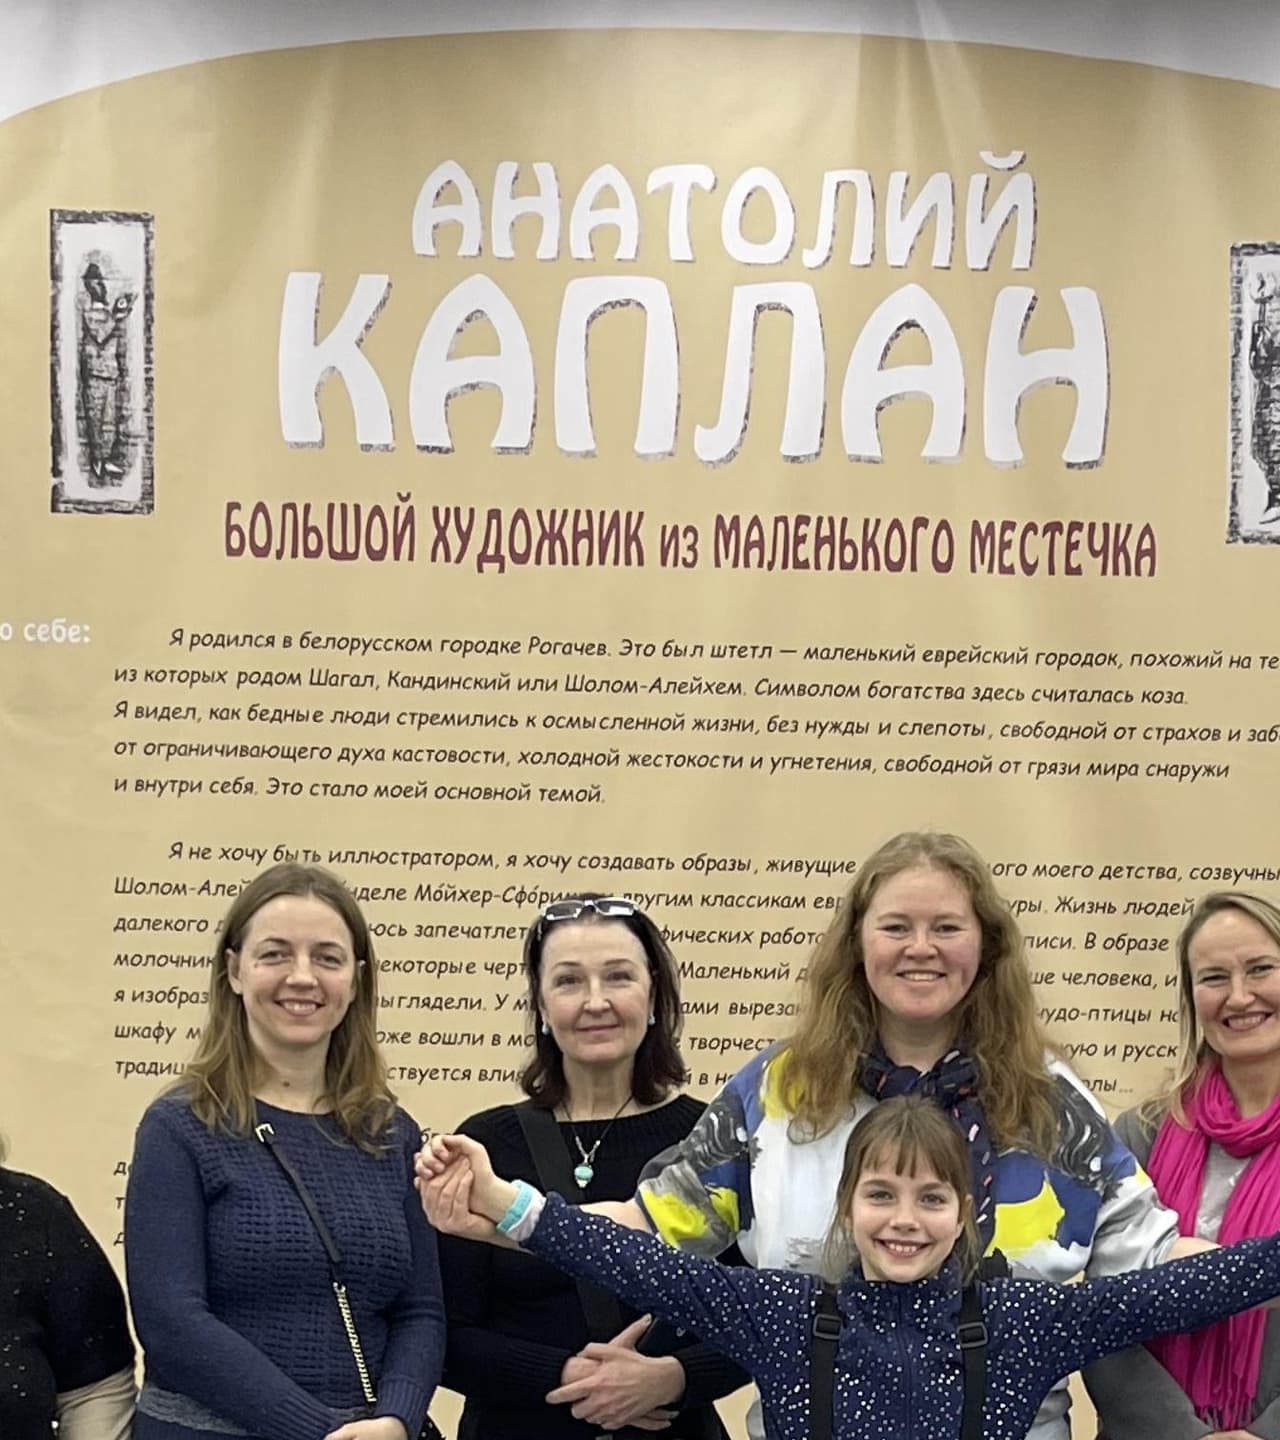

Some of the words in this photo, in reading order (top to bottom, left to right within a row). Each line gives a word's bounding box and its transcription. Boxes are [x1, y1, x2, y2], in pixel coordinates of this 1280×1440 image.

[411, 150, 1037, 272] АНАТОЛИЙ
[276, 268, 1113, 472] КАПЛАН
[224, 491, 416, 563] БОЛЬШОЙ
[430, 504, 645, 575] ХУДОЖНИК
[659, 523, 700, 569] из
[713, 513, 956, 575] МАЛЕНЬКОГО
[969, 519, 1157, 578] МЕСТЕЧКА
[23, 617, 91, 644] себе:
[168, 627, 185, 647] Я
[188, 632, 276, 653] родился
[281, 635, 293, 649] в
[299, 630, 433, 657] белорусском
[439, 639, 522, 660] городке
[618, 638, 657, 658] Это
[661, 638, 705, 659] был
[709, 644, 773, 660] штетл
[802, 642, 916, 663] маленький
[921, 644, 1029, 670] еврейский
[1129, 649, 1224, 669] похожий
[1228, 654, 1252, 670] на
[113, 668, 138, 683] из
[143, 668, 229, 690] которых
[235, 670, 303, 691] родом
[387, 669, 512, 692] Кандинский
[516, 677, 559, 693] или
[754, 677, 861, 699] Символом
[867, 679, 966, 701] богатства
[970, 686, 1026, 703] здесь
[1030, 687, 1135, 704] считалась
[113, 699, 129, 719] Я
[208, 707, 242, 721] как
[246, 702, 325, 725] бедные
[329, 709, 391, 728] люди
[396, 711, 519, 732] стремились
[525, 714, 538, 729] к
[542, 711, 686, 732] осмысленной
[766, 714, 800, 734] без
[804, 719, 871, 740] нужды
[877, 721, 892, 736] и
[999, 719, 1108, 742] свободной
[1112, 726, 1138, 741] от
[1142, 726, 1222, 747] страхов
[1227, 728, 1242, 743] и
[113, 741, 138, 756] от
[142, 741, 333, 764] ограничивающего
[336, 746, 386, 767] духа
[516, 747, 621, 769] холодной
[625, 753, 745, 769] жестокости
[749, 755, 764, 770] и
[883, 753, 993, 776] свободной
[998, 759, 1023, 775] от
[1027, 760, 1081, 781] грязи
[1085, 762, 1140, 782] мира
[1145, 762, 1230, 784] снаружи
[113, 778, 128, 793] и
[134, 778, 204, 799] внутри
[265, 776, 304, 797] Это
[309, 782, 369, 798] стало
[372, 779, 429, 799] моей
[433, 782, 532, 802] основной
[167, 841, 184, 860] Я
[188, 846, 213, 861] не
[217, 847, 269, 867] хочу
[272, 843, 322, 863] быть
[505, 854, 518, 868] я
[522, 854, 573, 875] хочу
[576, 855, 676, 872] создавать
[765, 859, 857, 879] живущие
[1031, 863, 1095, 879] моего
[699, 893, 807, 909] классикам
[1053, 895, 1118, 915] Жизнь
[1122, 897, 1195, 919] людей
[112, 917, 209, 933] далекого
[1083, 931, 1097, 950] В
[1101, 932, 1170, 957] образе
[676, 960, 791, 981] Маленький
[113, 989, 126, 1003] я
[493, 992, 510, 1012] У
[113, 1019, 178, 1045] шкафу
[417, 1031, 485, 1047] вошли
[490, 1033, 502, 1047] в
[1102, 1043, 1118, 1058] и
[698, 1072, 709, 1087] в
